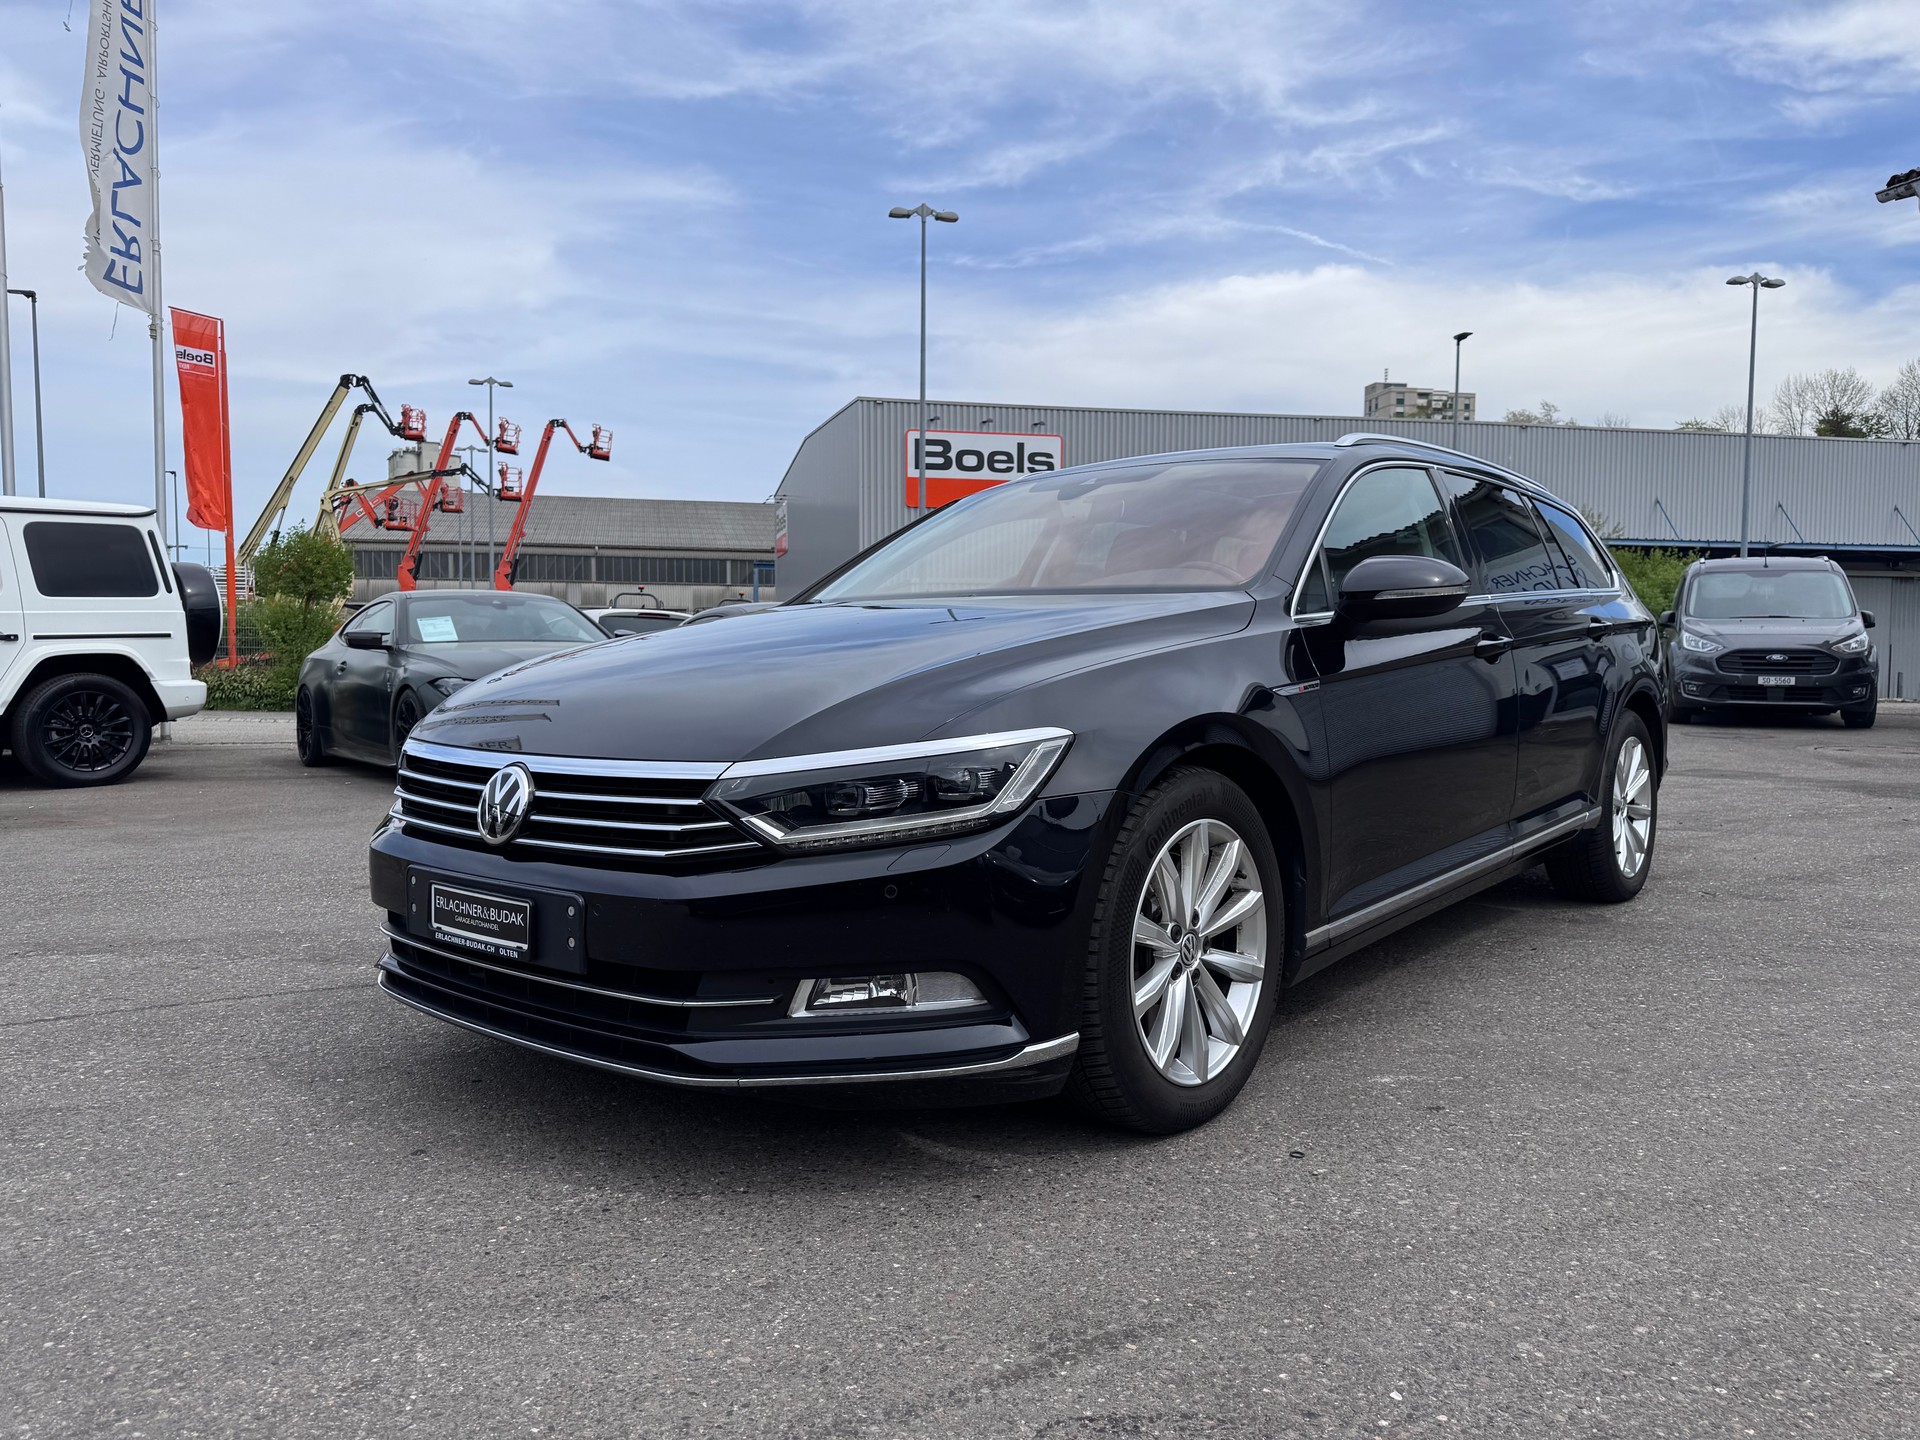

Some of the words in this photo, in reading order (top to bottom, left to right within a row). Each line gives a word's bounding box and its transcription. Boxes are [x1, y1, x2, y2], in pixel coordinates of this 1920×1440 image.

[914, 438, 1055, 474] Boels
[435, 895, 525, 926] ERLACHNER&BUDAK
[435, 932, 495, 953] ERLACHNER-BUDAK.CH
[499, 947, 518, 959] OLTEN
